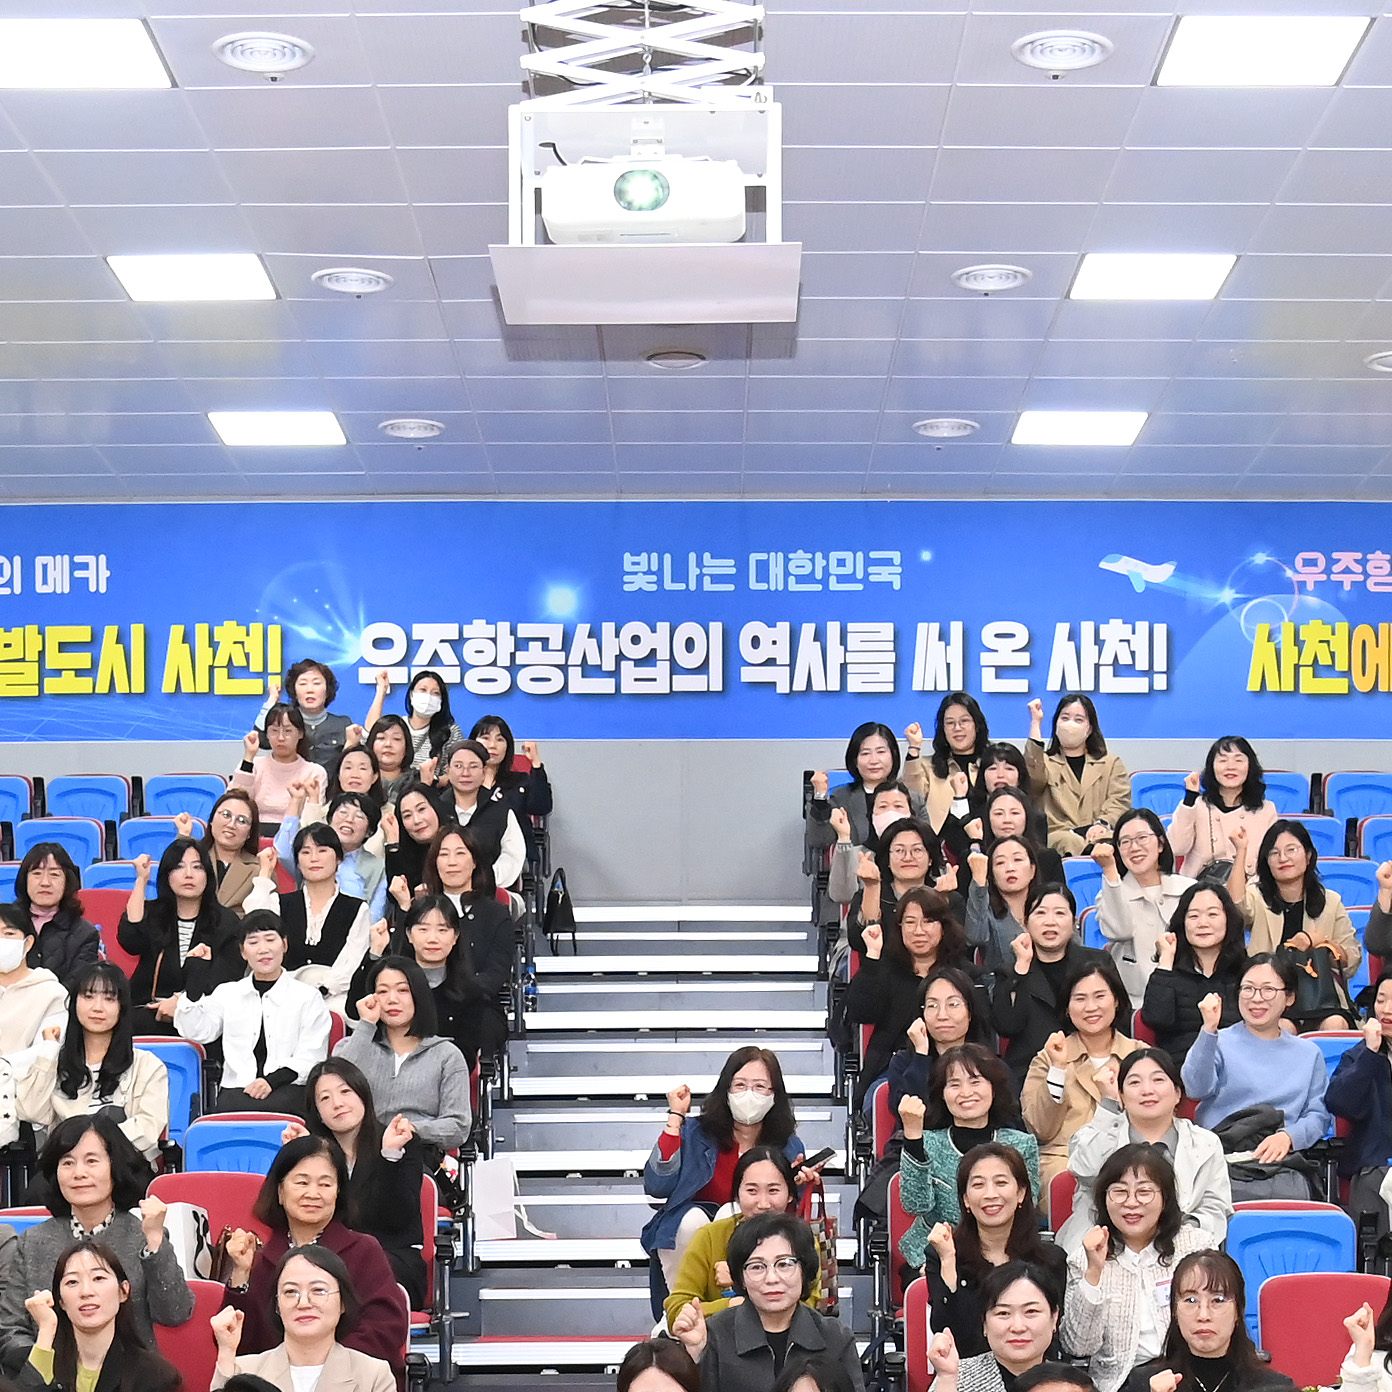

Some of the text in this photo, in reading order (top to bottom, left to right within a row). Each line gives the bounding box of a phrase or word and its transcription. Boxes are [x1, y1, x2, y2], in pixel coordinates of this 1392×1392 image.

[35, 553, 112, 596] 메카
[622, 550, 904, 594] 빛나는 대한민국
[162, 620, 284, 696] 사천!
[357, 618, 1169, 695] 우주항공산업의 역사를 써 온 사천!
